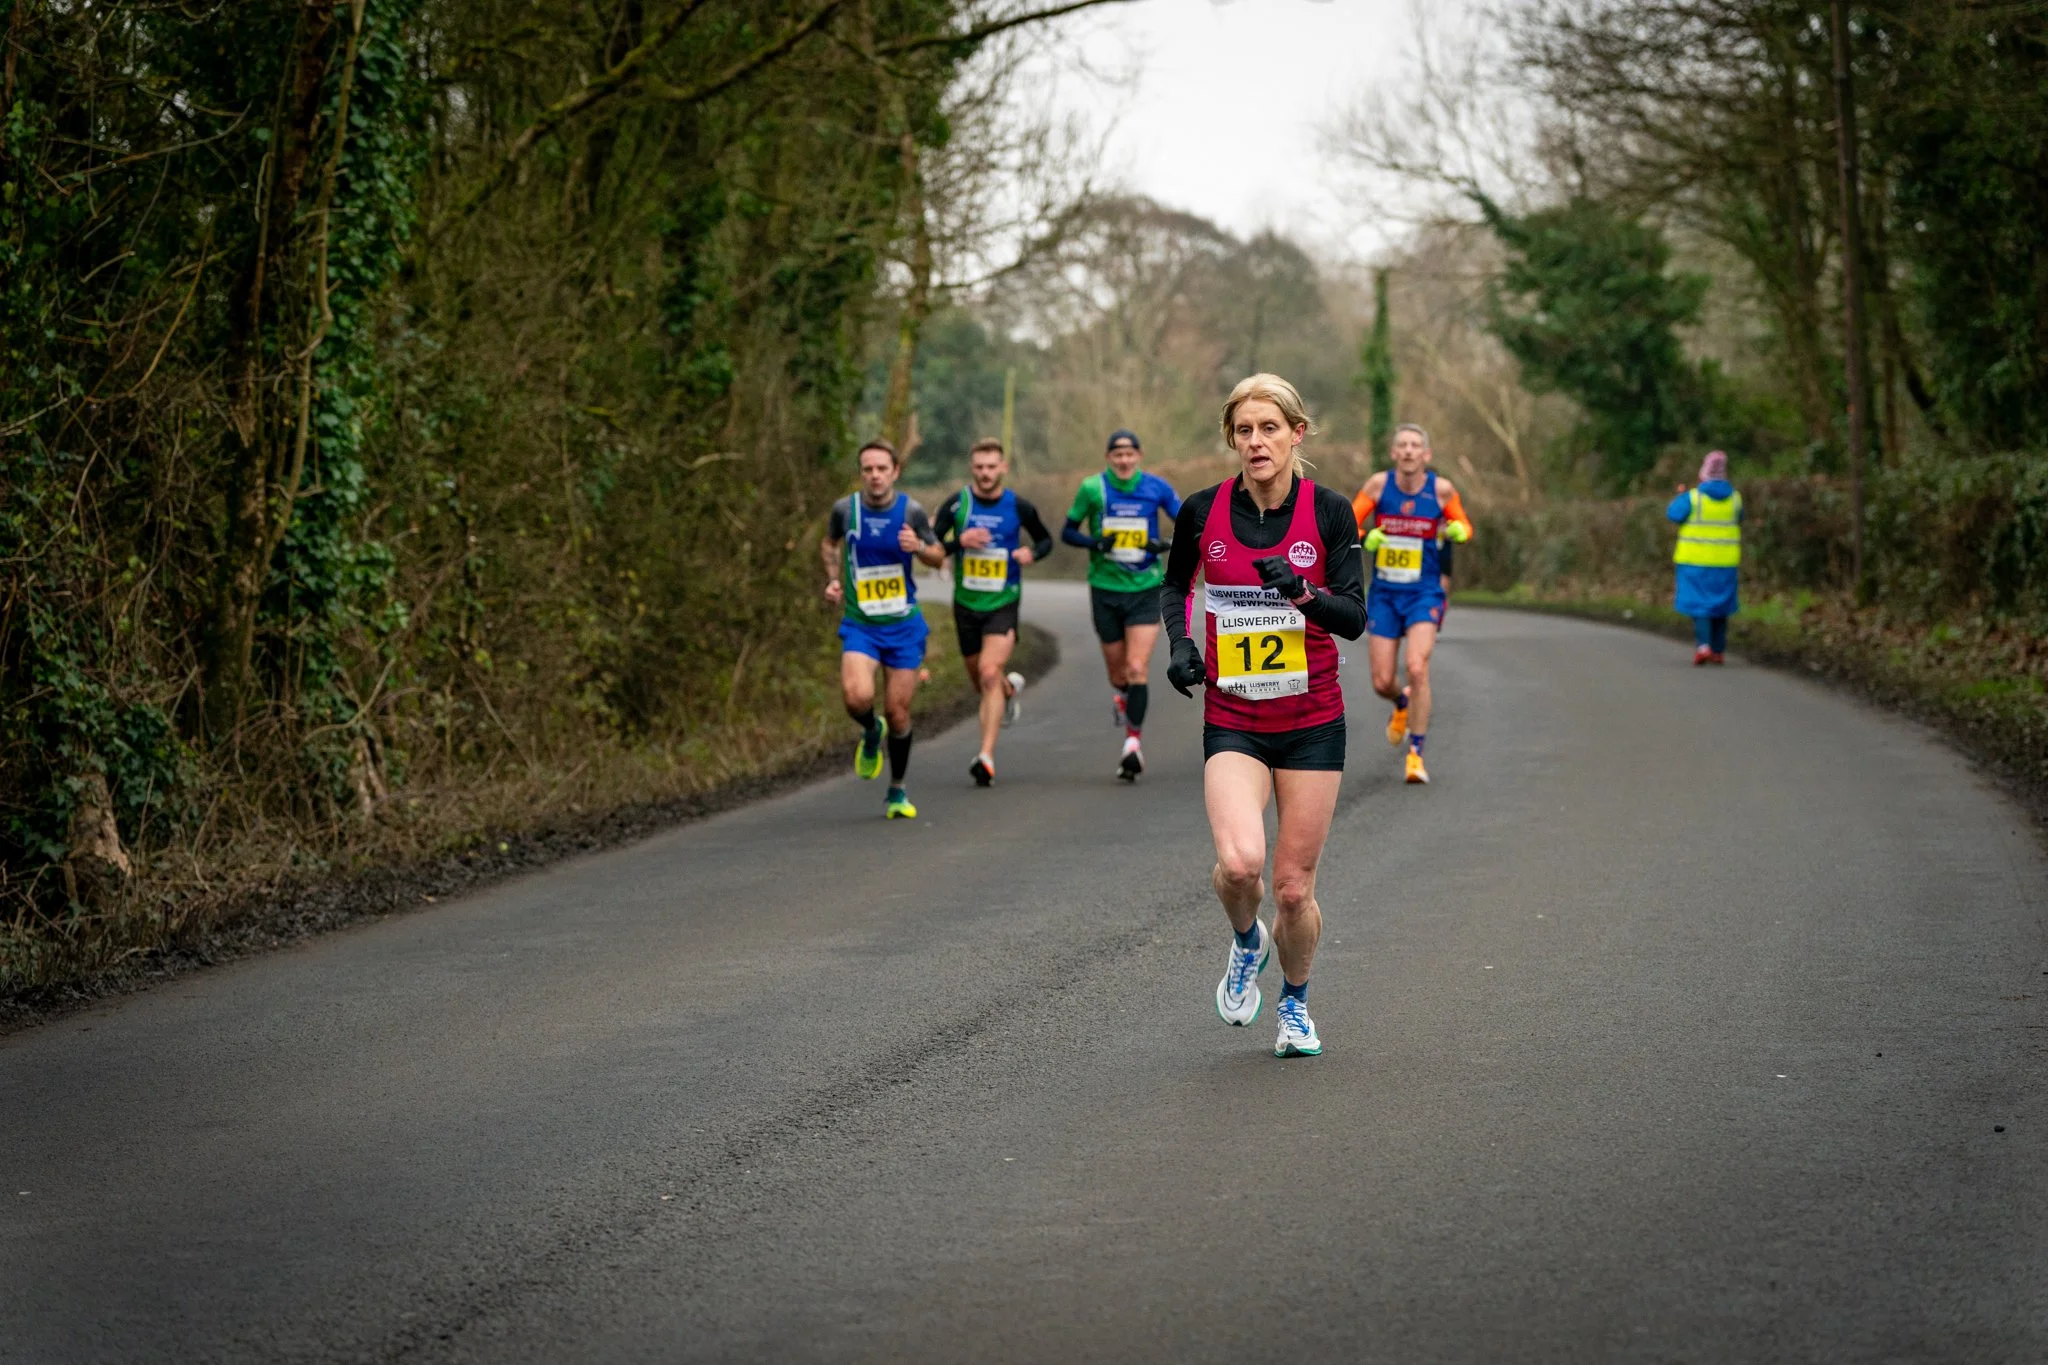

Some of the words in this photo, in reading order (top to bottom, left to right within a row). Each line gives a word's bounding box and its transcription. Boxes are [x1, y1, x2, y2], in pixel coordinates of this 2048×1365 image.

[1385, 549, 1410, 567] 86
[969, 558, 1002, 577] 151
[862, 578, 900, 599] 109
[1208, 589, 1261, 599] LLISWERRY
[1222, 616, 1287, 628] LLISWERRY
[1290, 616, 1297, 625] 8
[1236, 634, 1286, 671] 12
